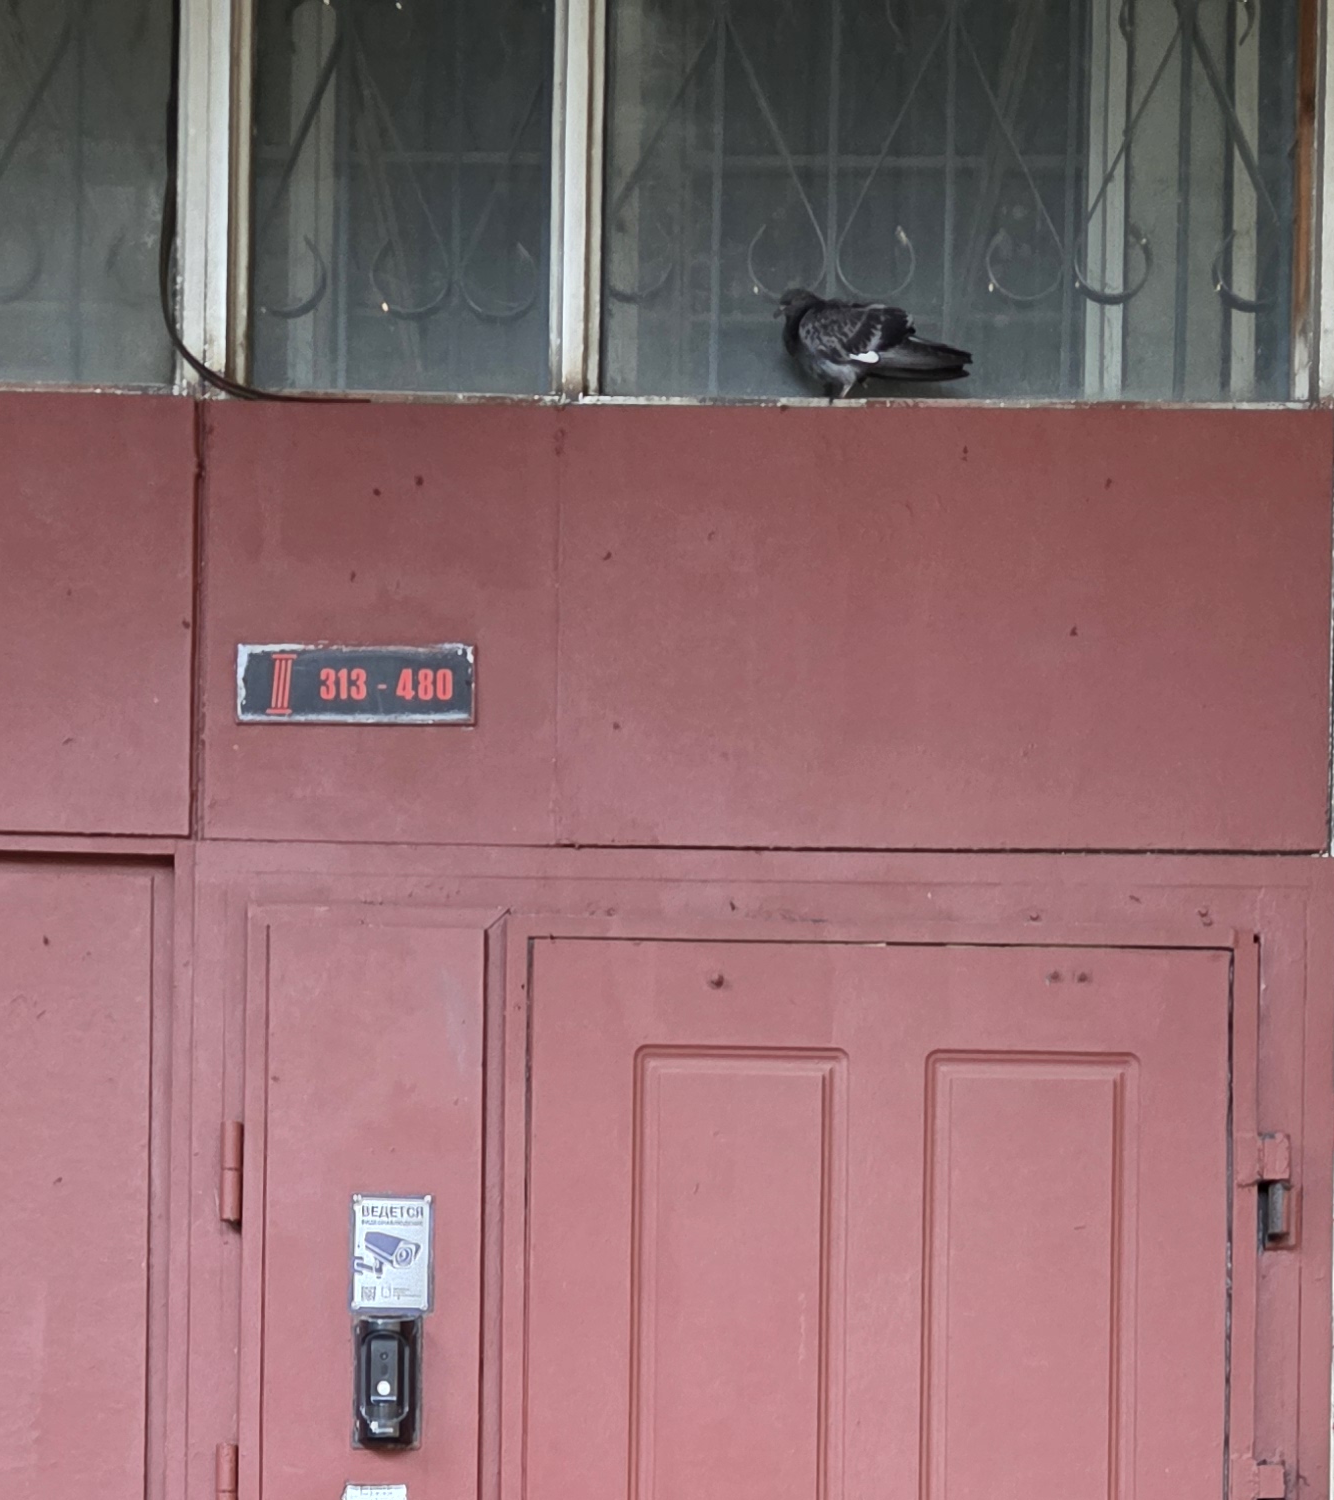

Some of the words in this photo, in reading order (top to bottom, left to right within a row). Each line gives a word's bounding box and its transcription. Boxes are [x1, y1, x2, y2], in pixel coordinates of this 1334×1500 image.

[320, 668, 367, 700] 313
[396, 667, 453, 701] 480
[362, 1205, 424, 1219] ВЕДЕТСЯ
